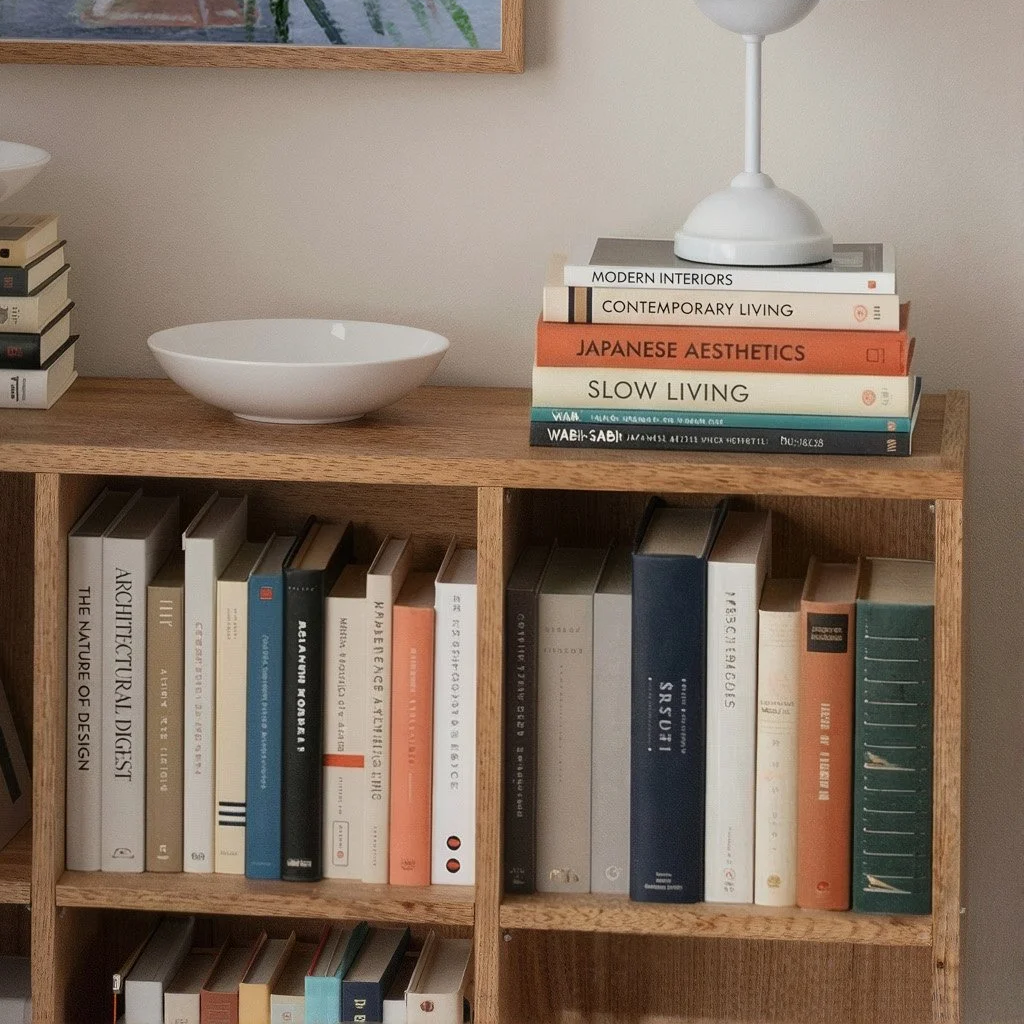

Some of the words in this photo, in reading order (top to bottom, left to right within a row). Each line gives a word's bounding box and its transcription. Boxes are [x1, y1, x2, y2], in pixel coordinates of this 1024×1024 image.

[592, 270, 656, 285] MODERN
[659, 272, 733, 286] INTERIORS
[602, 299, 734, 317] CONTEMPORARY
[739, 301, 794, 318] LIVING
[576, 338, 678, 359] JAPANESE
[684, 341, 806, 362] AESTHETICS
[588, 380, 657, 401] SLOW
[667, 382, 750, 403] LIVING
[78, 586, 91, 616] THE
[77, 621, 92, 681] NATURE
[114, 567, 133, 716] ARCHITECTURAL
[77, 685, 91, 708] OF
[77, 712, 91, 772] DESIGN
[113, 718, 133, 783] DIGEST
